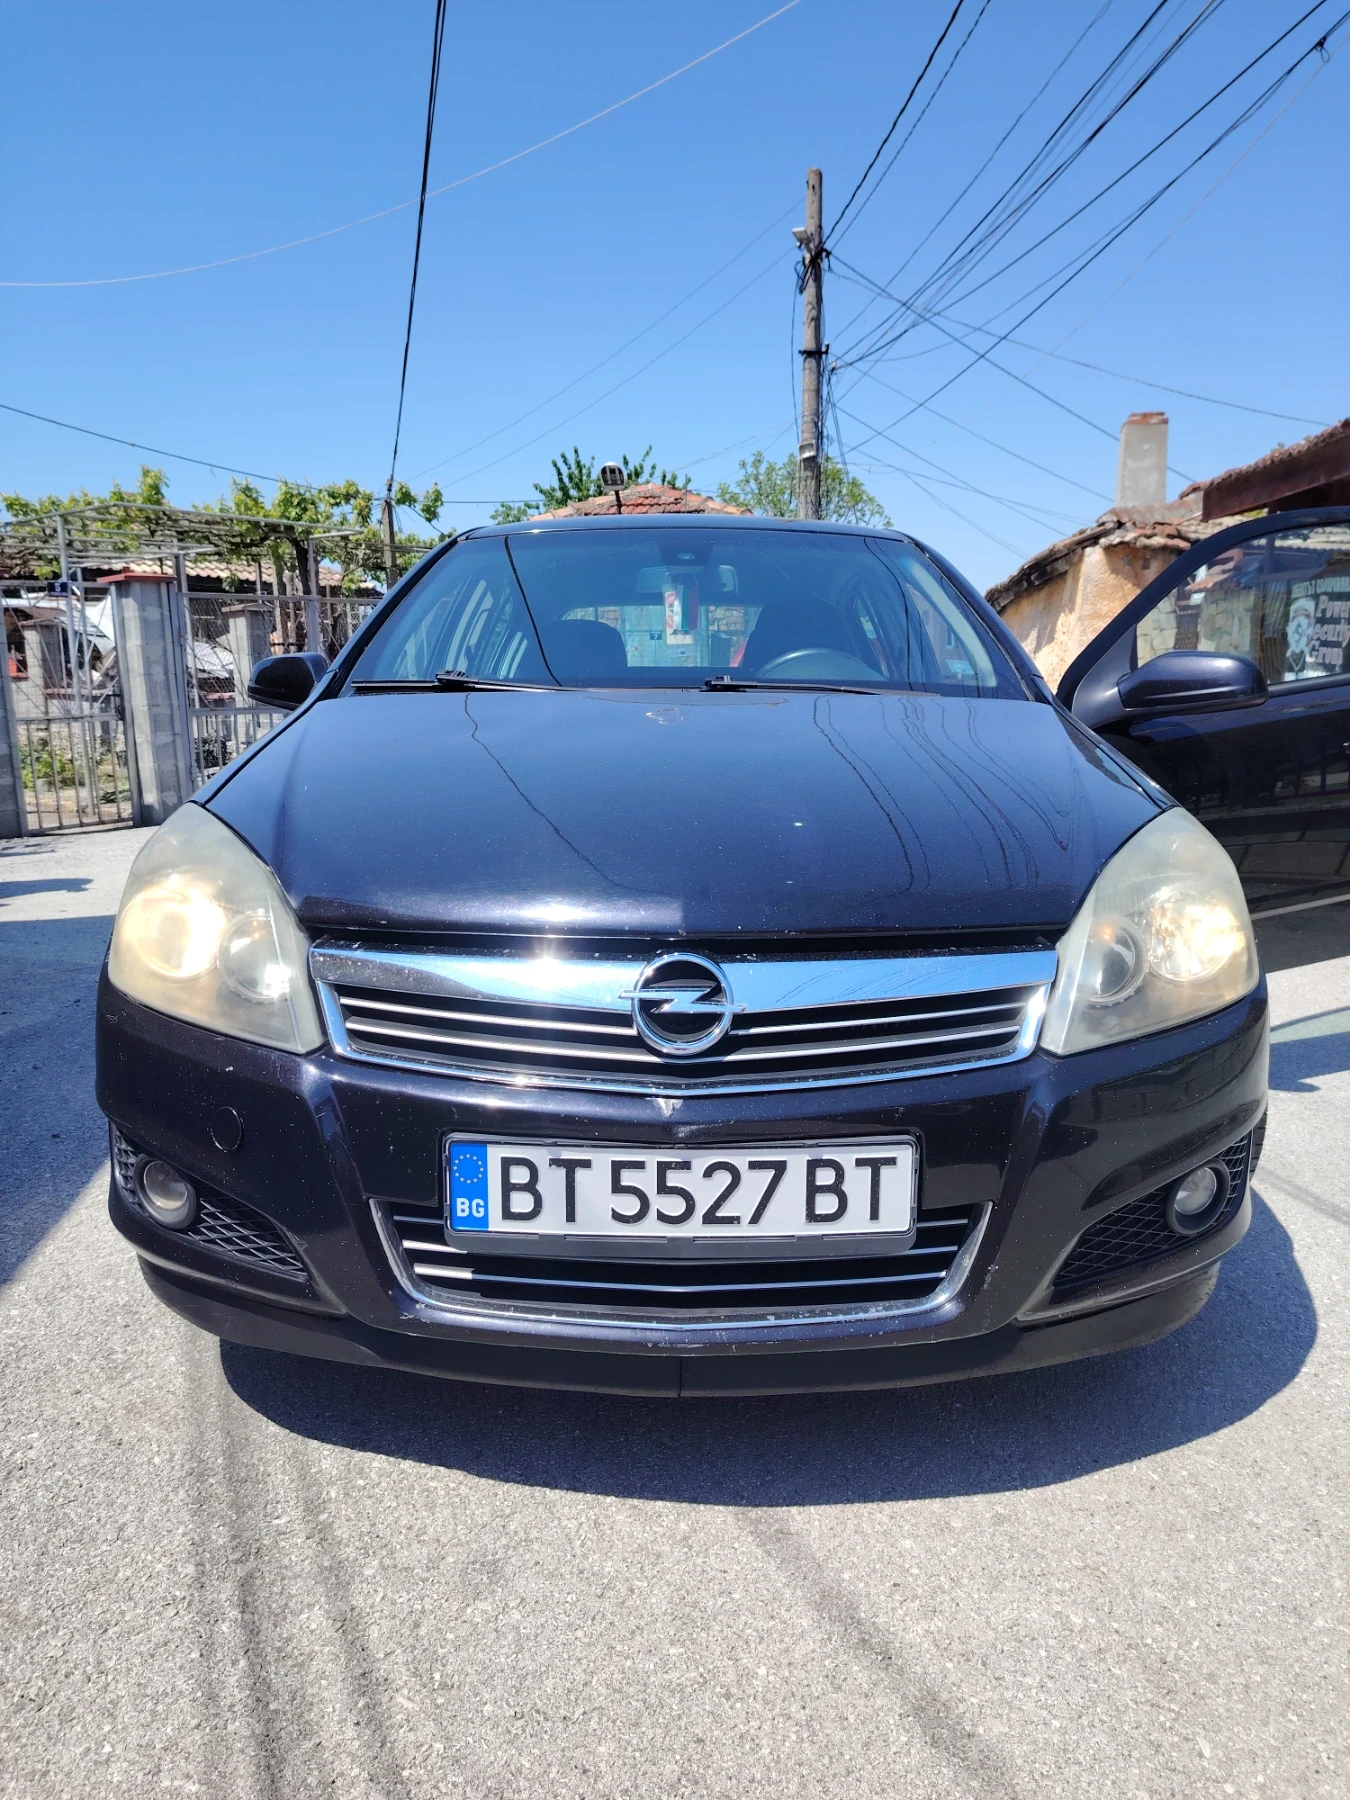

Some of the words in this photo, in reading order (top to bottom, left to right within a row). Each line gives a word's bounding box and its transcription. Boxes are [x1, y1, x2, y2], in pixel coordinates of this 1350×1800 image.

[54, 582, 61, 592] 5
[500, 1156, 592, 1223] BT
[610, 1159, 787, 1225] 5527
[805, 1156, 897, 1223] BT
[456, 1198, 485, 1217] BG
